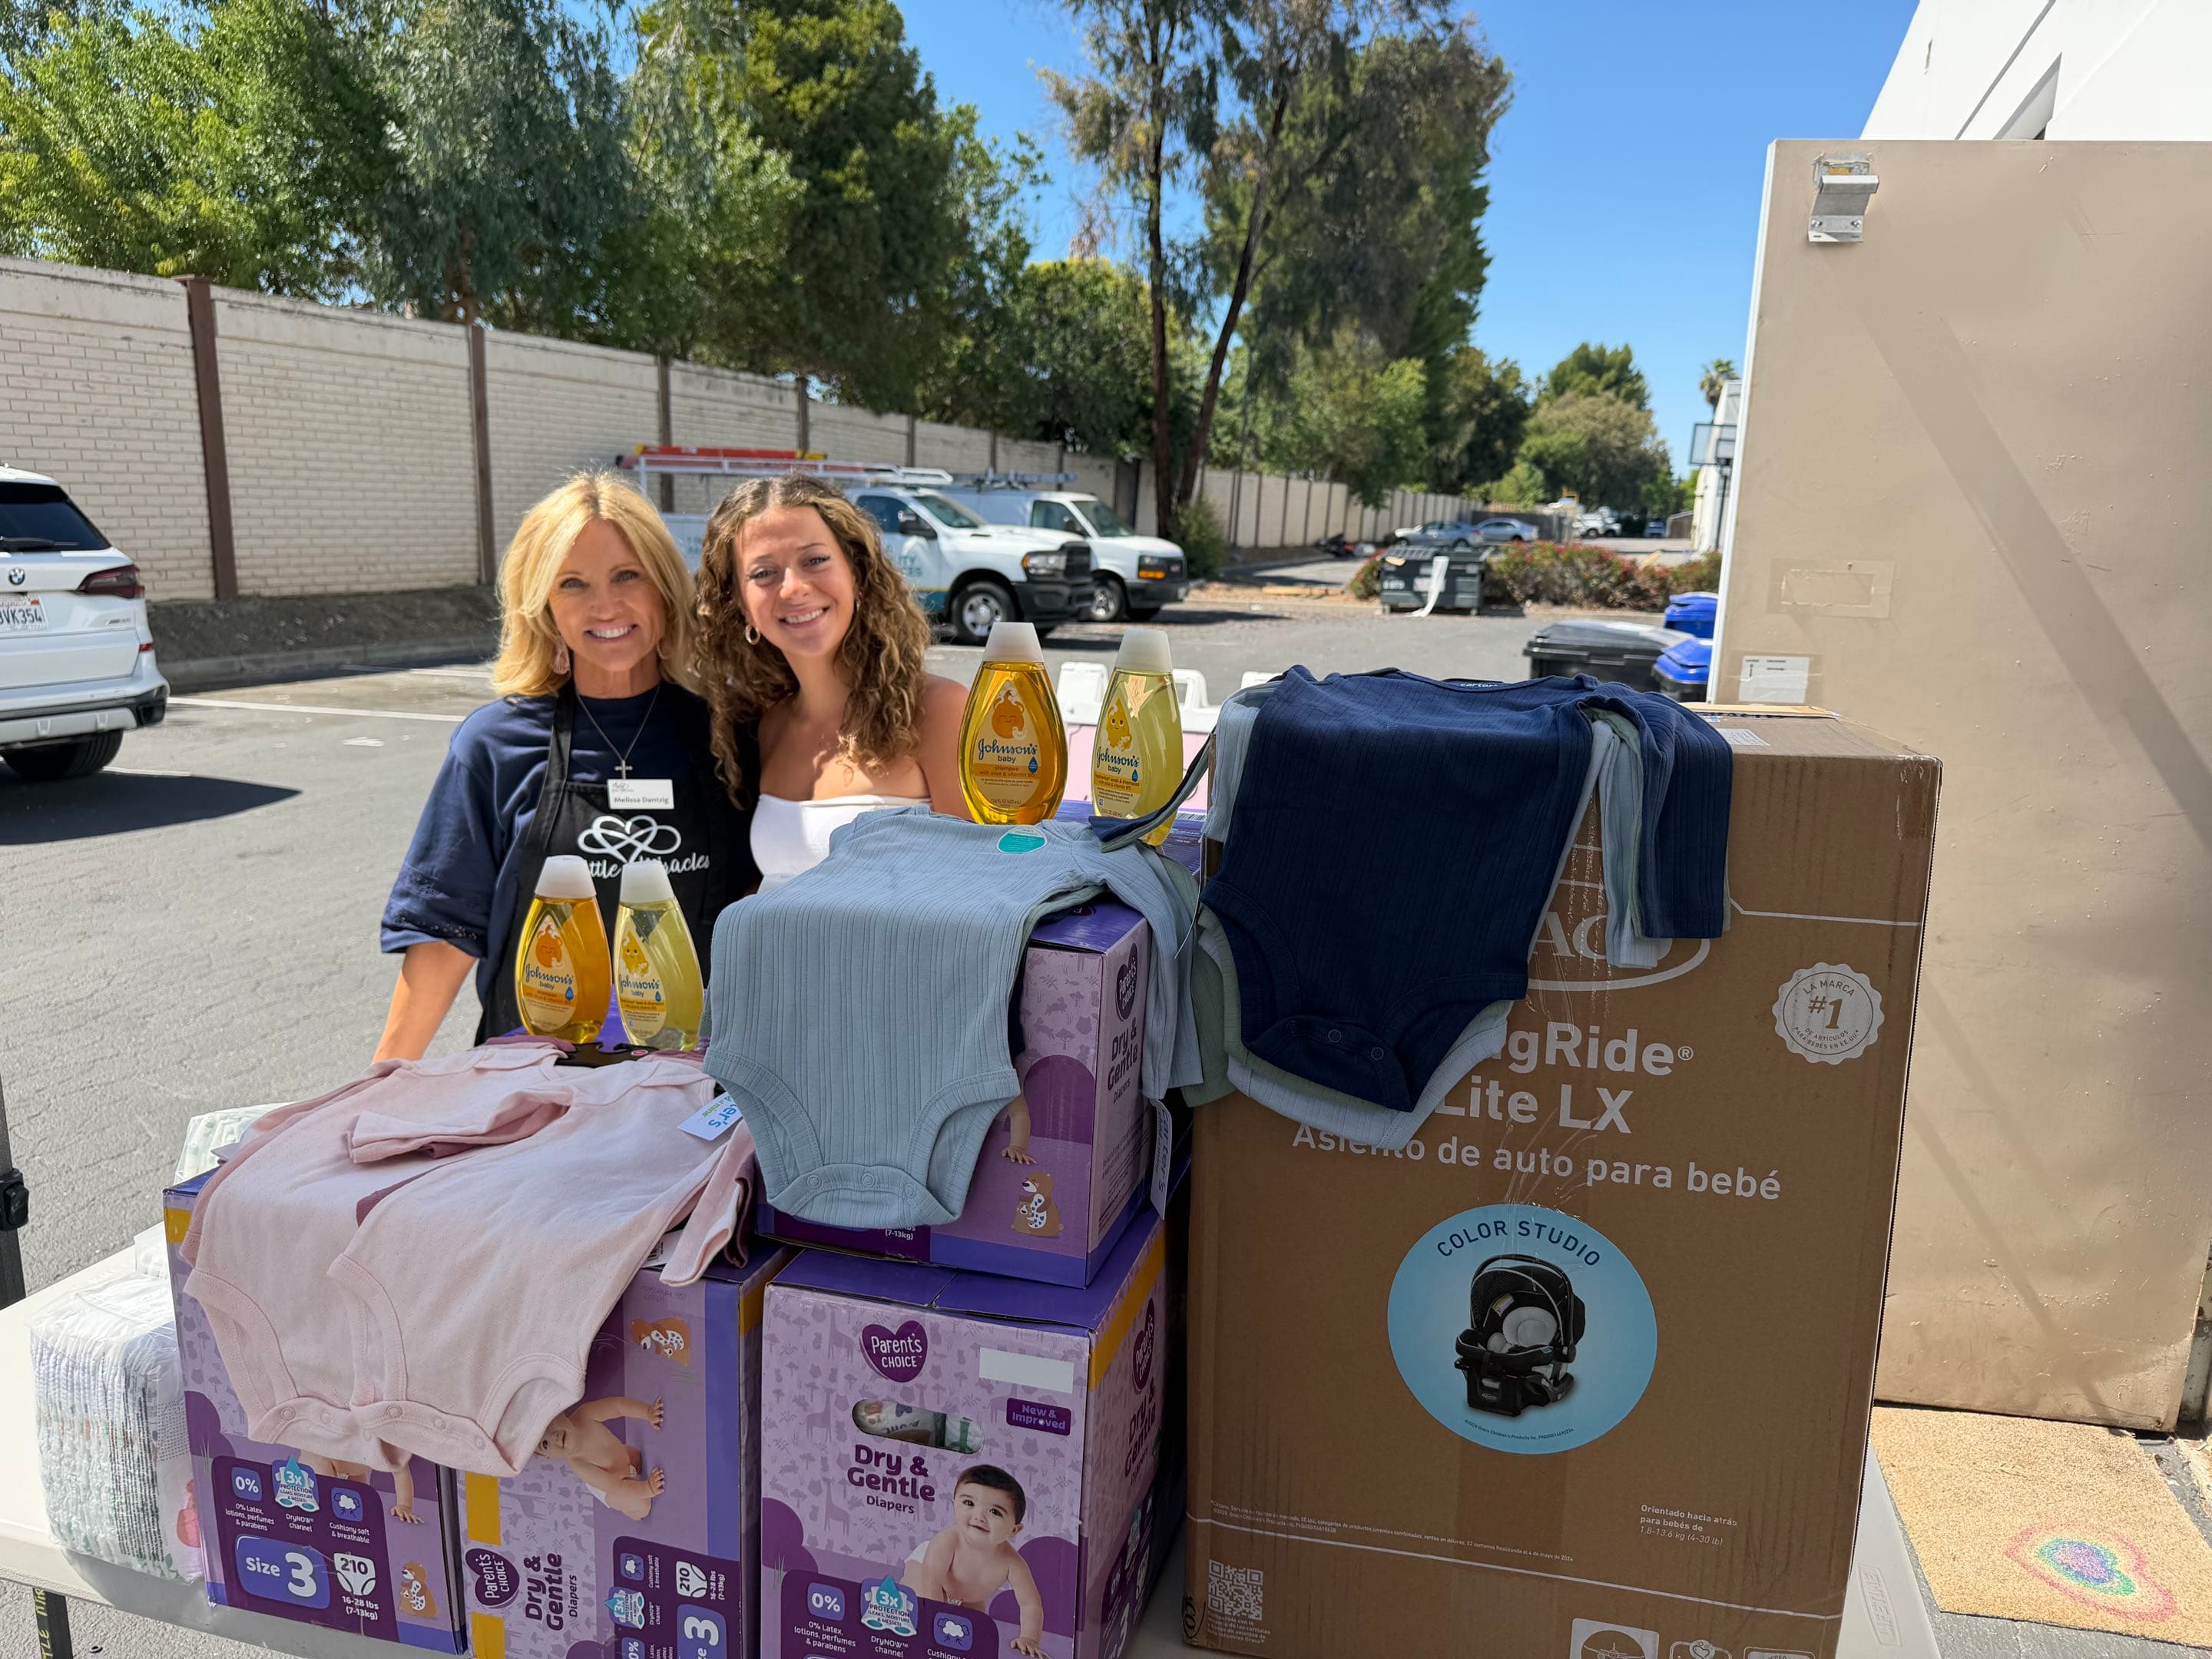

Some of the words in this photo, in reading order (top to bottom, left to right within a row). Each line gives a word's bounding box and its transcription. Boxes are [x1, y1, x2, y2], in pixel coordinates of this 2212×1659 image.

[998, 755, 1016, 763] baby
[1108, 765, 1121, 774] baby
[589, 859, 622, 879] ttle
[539, 982, 555, 991] baby
[1803, 984, 1817, 995] LA
[1820, 980, 1855, 997] MARCA
[1808, 995, 1843, 1029] #1
[1111, 1028, 1129, 1062] Dry
[1131, 1016, 1137, 1038] &
[1793, 1026, 1806, 1041] PARA
[1805, 1028, 1813, 1036] DE
[1488, 1021, 1694, 1075] gRide®
[1108, 1042, 1138, 1091] Gentle
[1559, 1084, 1634, 1134] LX
[1437, 1136, 1481, 1168] de
[1492, 1144, 1573, 1178] auto
[1587, 1157, 1673, 1189] para
[1687, 1162, 1782, 1200] bebé
[885, 1229, 914, 1240] (7-13kg)
[1435, 1220, 1508, 1257] COLOR
[1517, 1220, 1602, 1267] STUDIO
[871, 1333, 923, 1354] Parent's
[1022, 1404, 1047, 1417] New
[1048, 1409, 1057, 1419] &
[1129, 1394, 1147, 1445] Dry
[854, 1444, 903, 1477] Dry
[909, 1455, 929, 1478] &
[235, 1475, 259, 1493] 0%
[286, 1470, 303, 1485] 3x
[846, 1466, 936, 1502] Gentle
[280, 1483, 313, 1494] PROTECTION
[246, 1505, 264, 1515] Latex,
[866, 1495, 916, 1515] Diapers
[225, 1508, 247, 1519] lotions,
[247, 1514, 275, 1525] perfumes
[1641, 1504, 1684, 1518] Orientado
[1687, 1511, 1711, 1522] hacia
[1714, 1517, 1737, 1527] atrás
[241, 1520, 268, 1531] parabens
[289, 1522, 313, 1532] channel
[329, 1522, 356, 1535] Cushiony
[357, 1528, 370, 1536] soft
[1640, 1517, 1661, 1525] para
[1662, 1518, 1690, 1530] bebés
[1692, 1523, 1704, 1532] de
[337, 1530, 370, 1544] breathable
[1641, 1525, 1673, 1538] 1.8-13.6
[1675, 1532, 1685, 1541] kg
[1687, 1532, 1710, 1544] (4-30
[1711, 1537, 1724, 1547] lb)
[340, 1557, 369, 1575] 210
[523, 1555, 541, 1572] &
[245, 1555, 281, 1578] Size
[284, 1551, 318, 1598] 3
[475, 1554, 500, 1599] Parent's
[679, 1568, 690, 1592] 210
[525, 1577, 547, 1621] Dry
[543, 1552, 564, 1631] Gentle
[568, 1575, 580, 1618] Diapers
[879, 1591, 899, 1608] 3x
[342, 1595, 365, 1607] 16-28
[366, 1600, 379, 1610] lbs
[614, 1598, 625, 1614] 3x
[811, 1592, 841, 1613] 0%
[869, 1604, 910, 1618] PROTECTION
[345, 1605, 379, 1621] (7-13kg)
[886, 1614, 910, 1624] MOISTURE
[684, 1616, 720, 1646] 3
[793, 1626, 820, 1640] lotions,
[822, 1631, 856, 1647] perfumes
[808, 1621, 821, 1630] 0%
[822, 1624, 844, 1636] Latex,
[813, 1640, 846, 1654] parabens
[875, 1645, 904, 1658] channel
